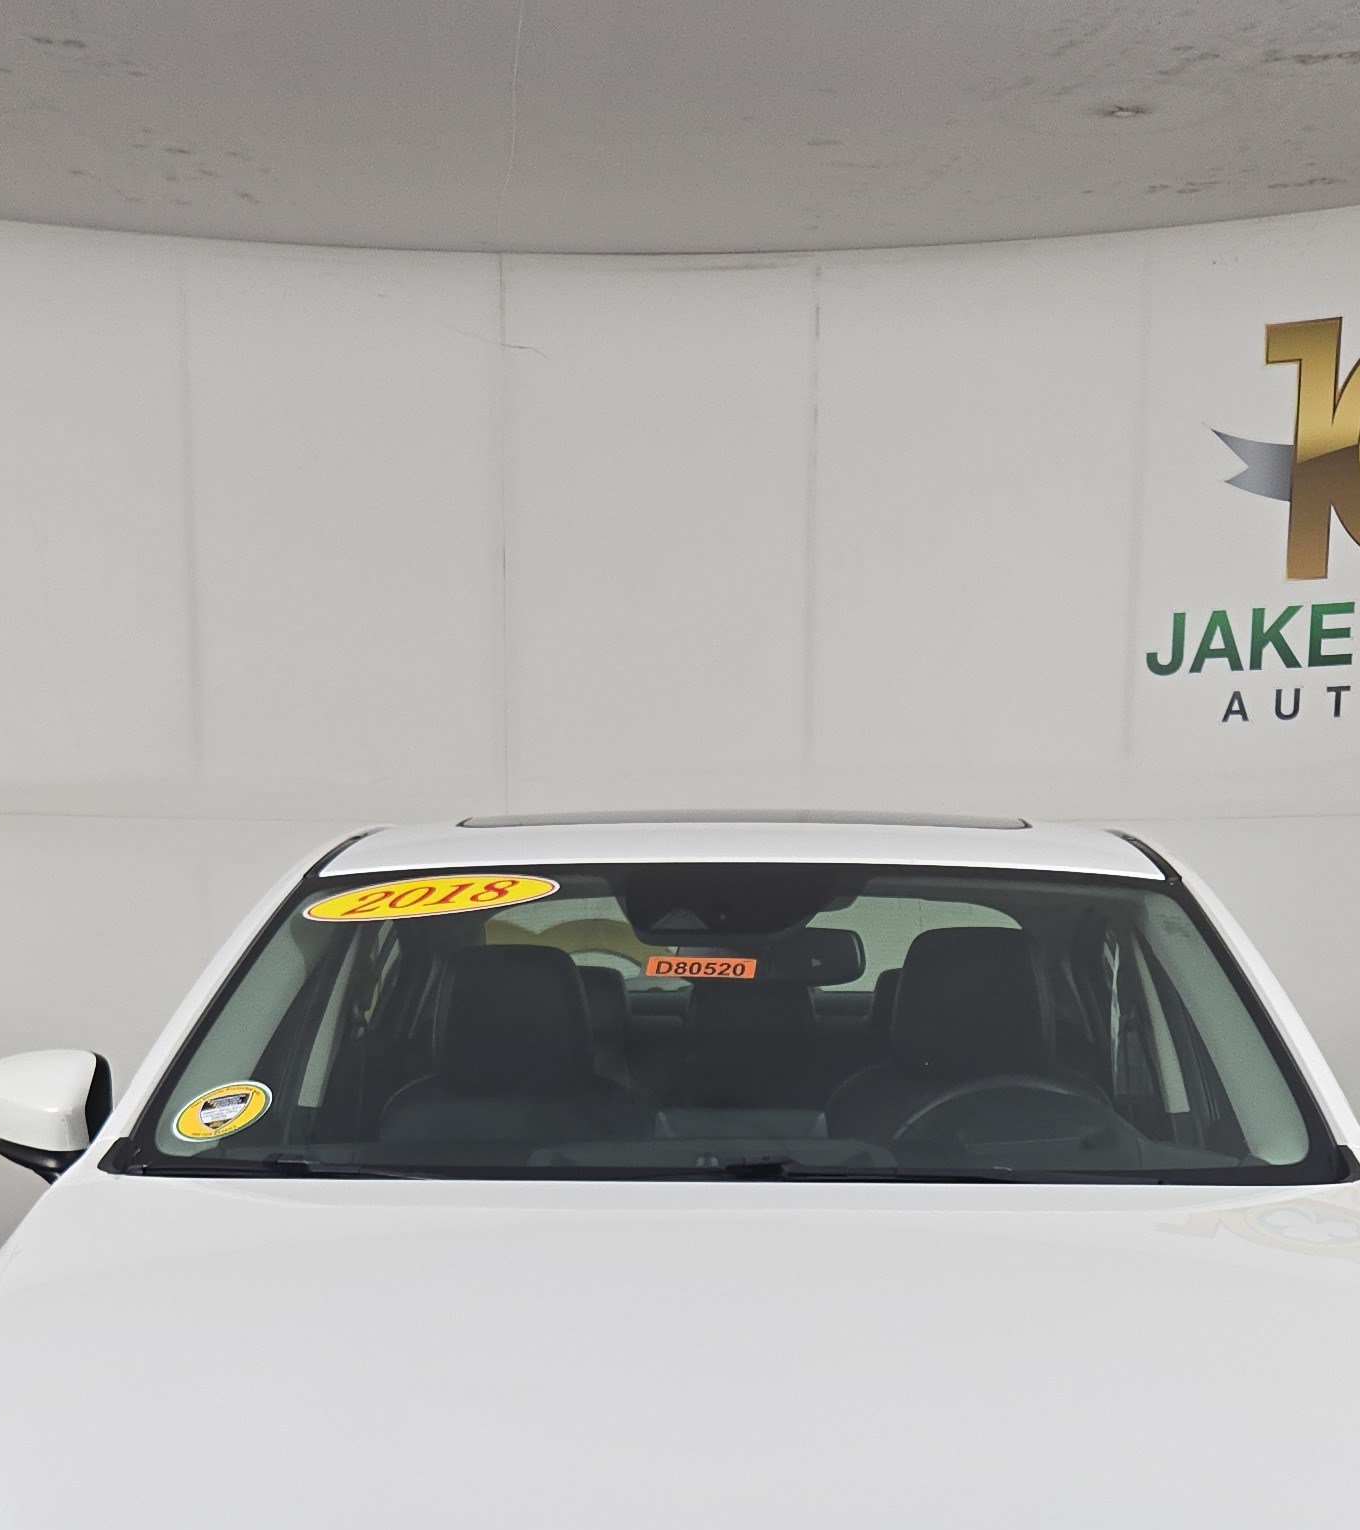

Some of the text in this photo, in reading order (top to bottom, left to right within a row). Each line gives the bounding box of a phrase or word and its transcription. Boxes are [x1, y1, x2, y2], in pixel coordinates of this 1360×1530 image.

[1145, 600, 1356, 676] JAKE
[339, 879, 521, 917] 2018
[655, 961, 746, 977] D80520
